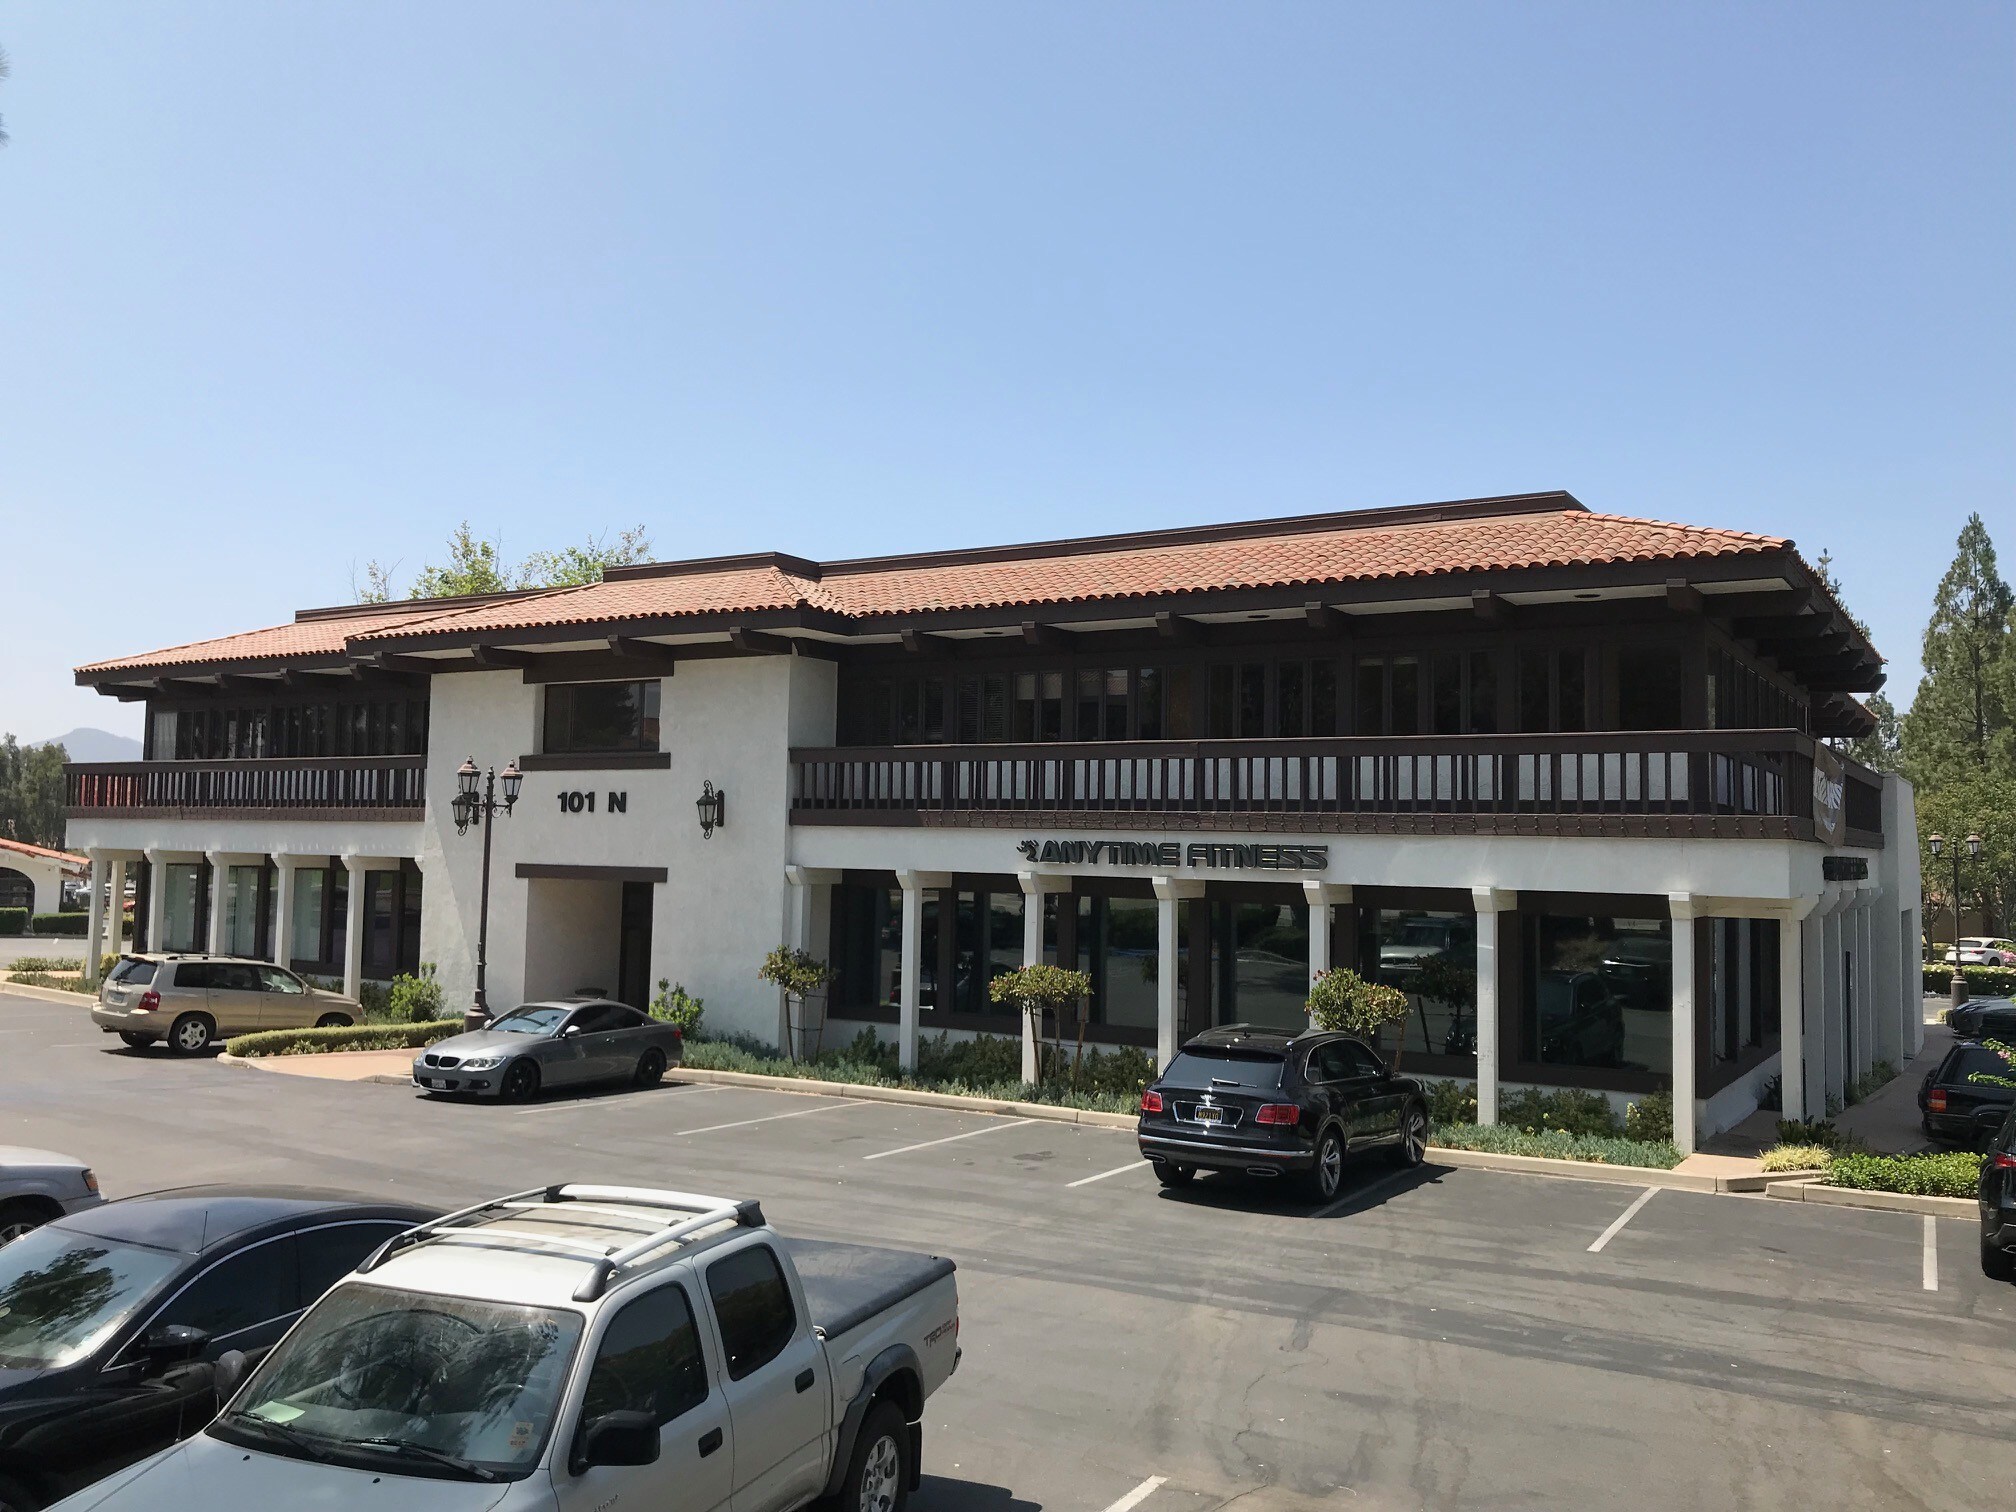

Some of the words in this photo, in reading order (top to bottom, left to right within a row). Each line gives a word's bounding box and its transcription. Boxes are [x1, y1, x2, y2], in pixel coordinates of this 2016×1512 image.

[557, 791, 595, 812] 101
[608, 791, 627, 813] N
[1038, 840, 1181, 868] ANYTIME
[1186, 842, 1329, 871] FITNESS
